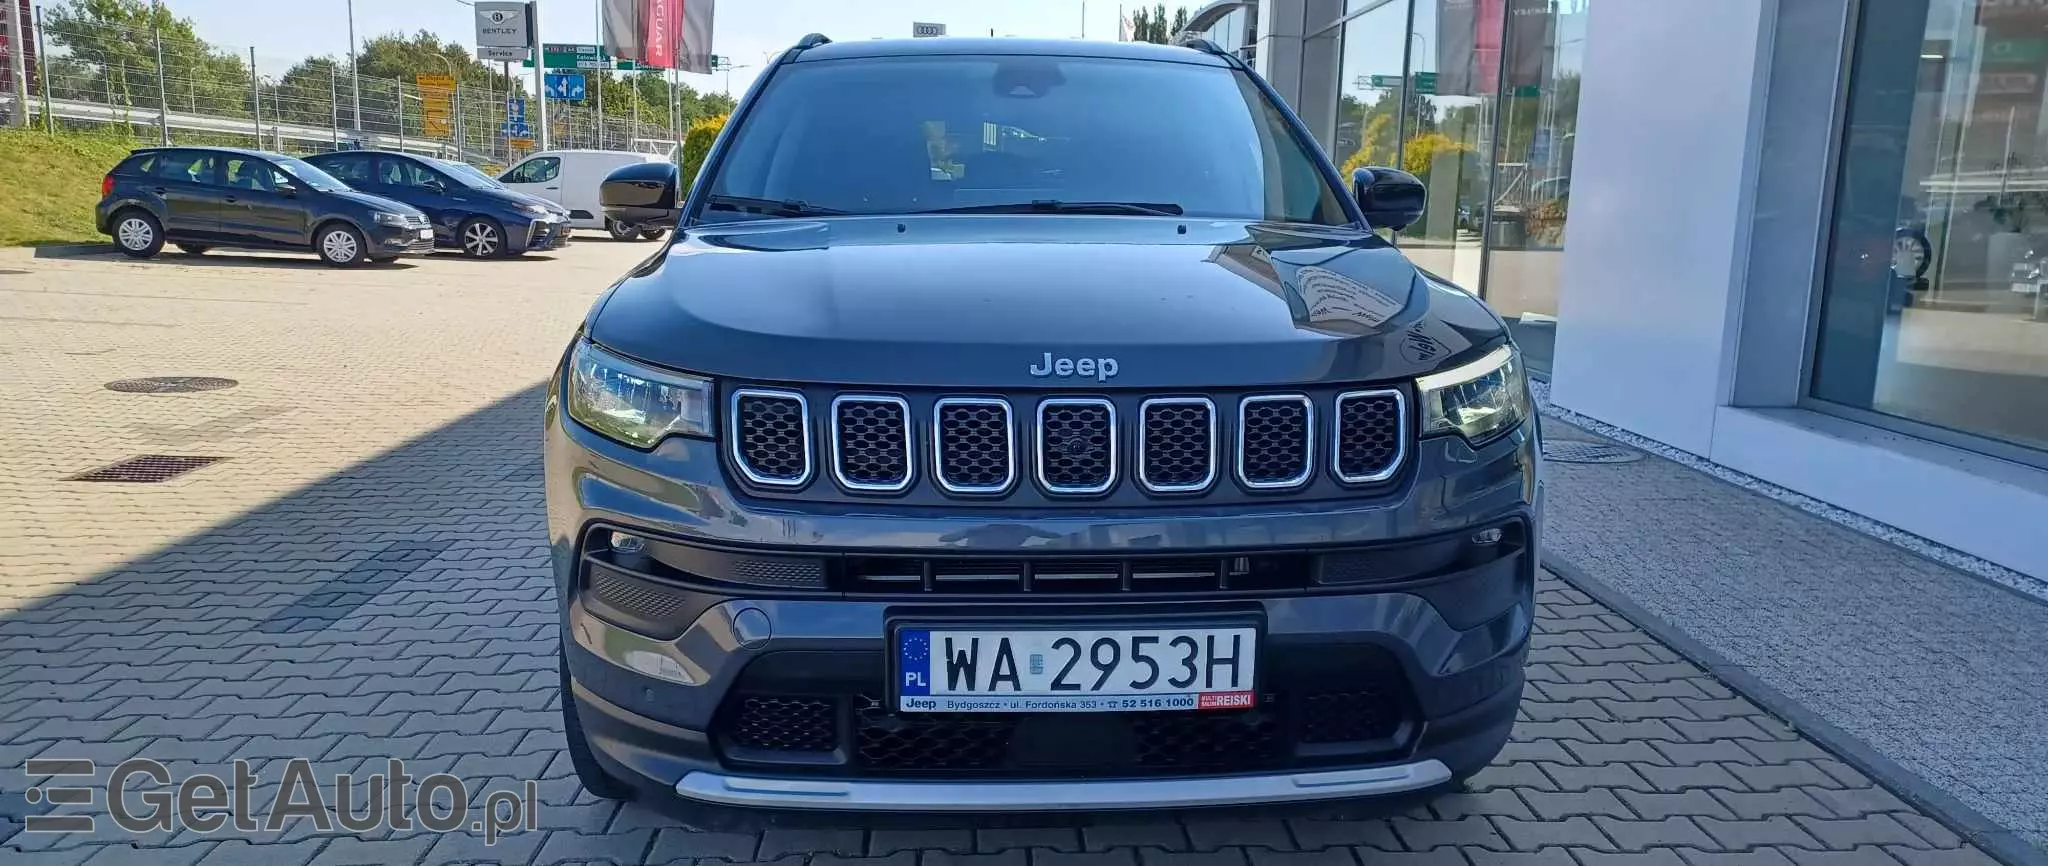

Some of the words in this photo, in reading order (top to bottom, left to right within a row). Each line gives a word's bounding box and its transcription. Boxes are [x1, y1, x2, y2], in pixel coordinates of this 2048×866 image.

[1030, 352, 1119, 382] Jeep
[945, 637, 1022, 691] WA
[1051, 634, 1241, 691] 2953H
[905, 672, 926, 687] PL
[906, 698, 937, 710] Jeep
[947, 701, 1000, 710] Bydgoszcz
[1080, 700, 1097, 709] 353
[1122, 699, 1137, 708] 52
[1140, 699, 1162, 708] 516
[1166, 698, 1194, 707] 1000
[1216, 695, 1251, 706] REISKI
